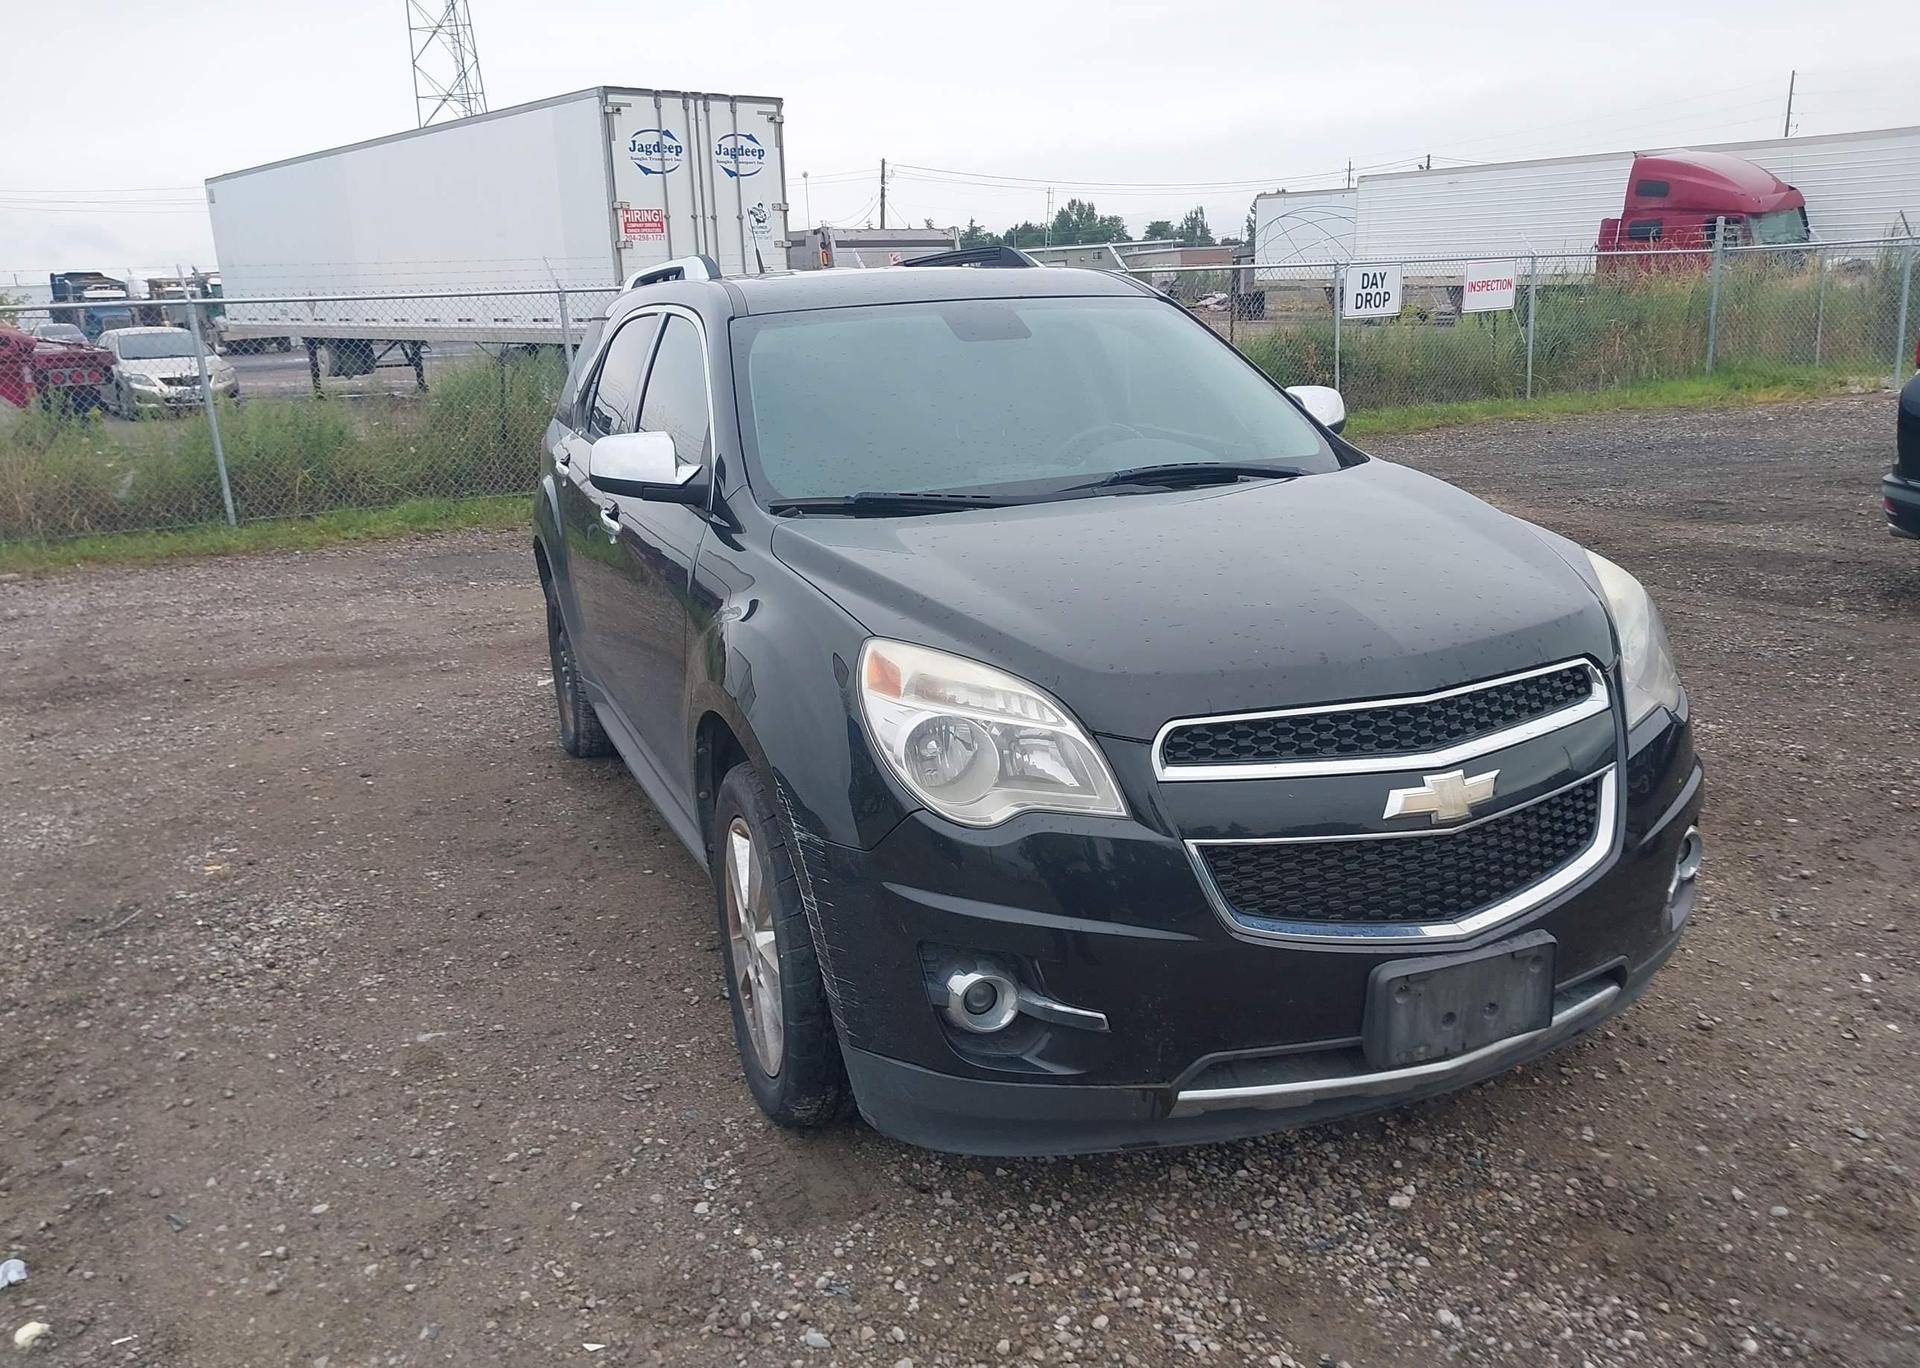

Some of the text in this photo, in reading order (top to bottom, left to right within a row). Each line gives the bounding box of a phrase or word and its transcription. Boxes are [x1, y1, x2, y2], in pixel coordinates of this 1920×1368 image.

[629, 140, 683, 157] Jagdeep
[715, 144, 765, 160] Jagdeep
[623, 210, 662, 223] HIRING!
[1361, 271, 1387, 290] DAY
[1467, 278, 1513, 293] INSPECTION
[1355, 291, 1391, 310] DROP
